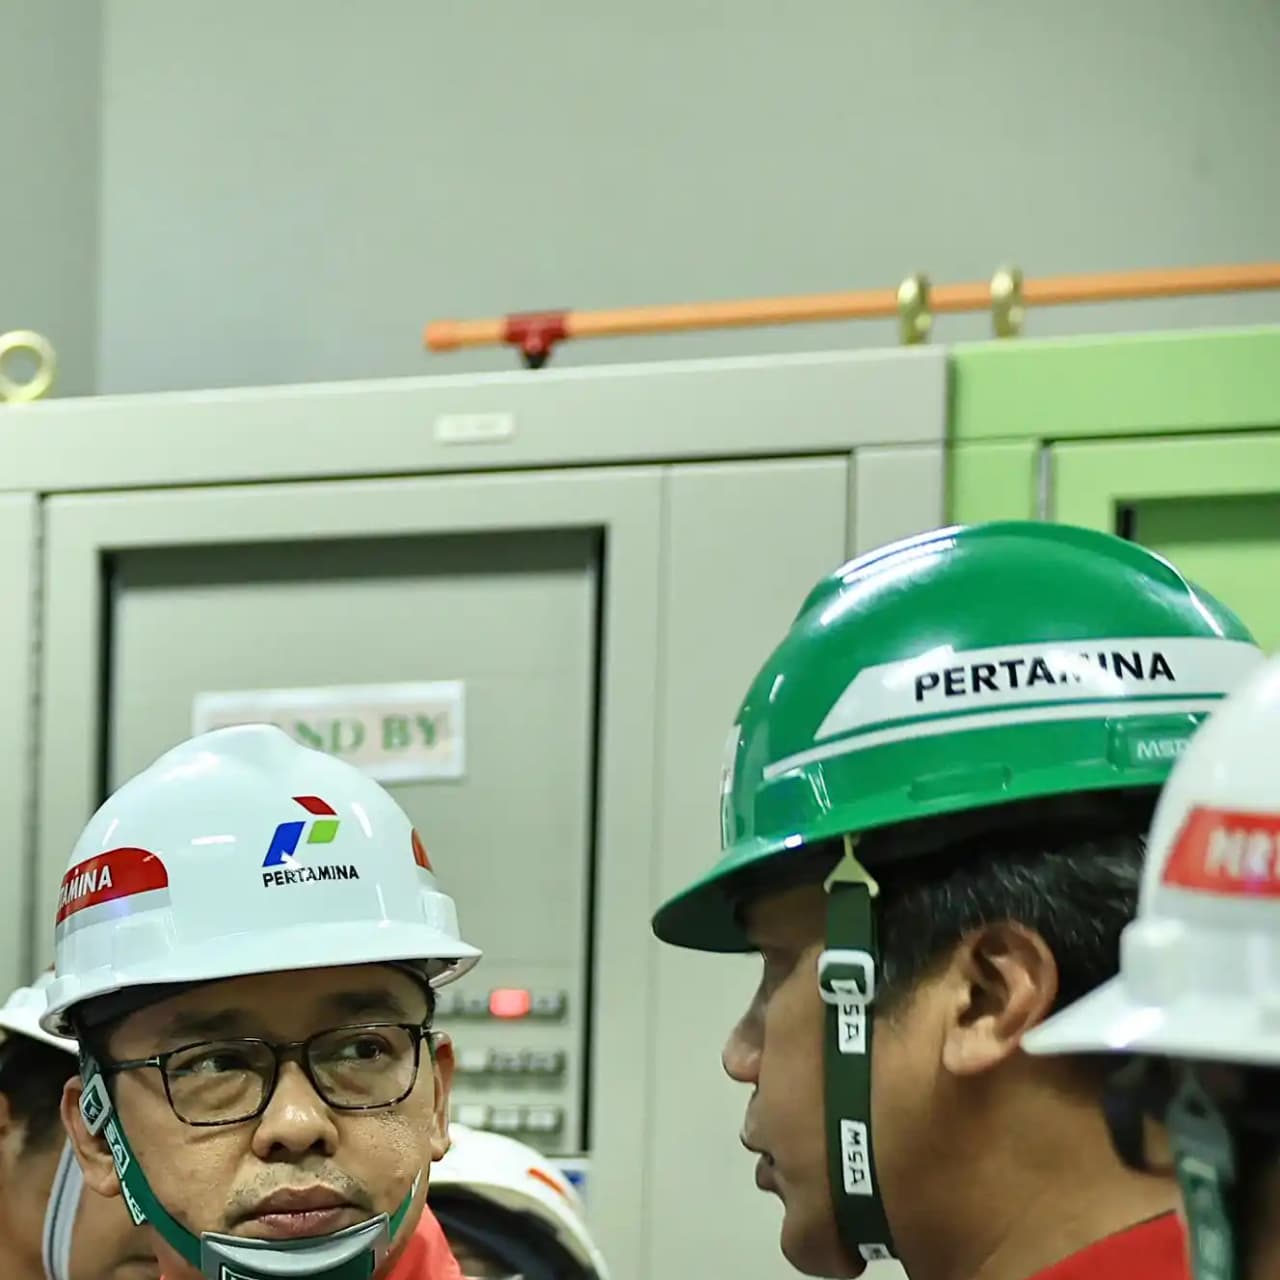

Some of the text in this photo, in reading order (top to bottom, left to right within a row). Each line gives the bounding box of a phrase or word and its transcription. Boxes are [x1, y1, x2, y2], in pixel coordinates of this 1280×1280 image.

[382, 712, 448, 751] BY
[262, 864, 360, 888] PERTAMINA
[847, 1127, 865, 1186] MSA
